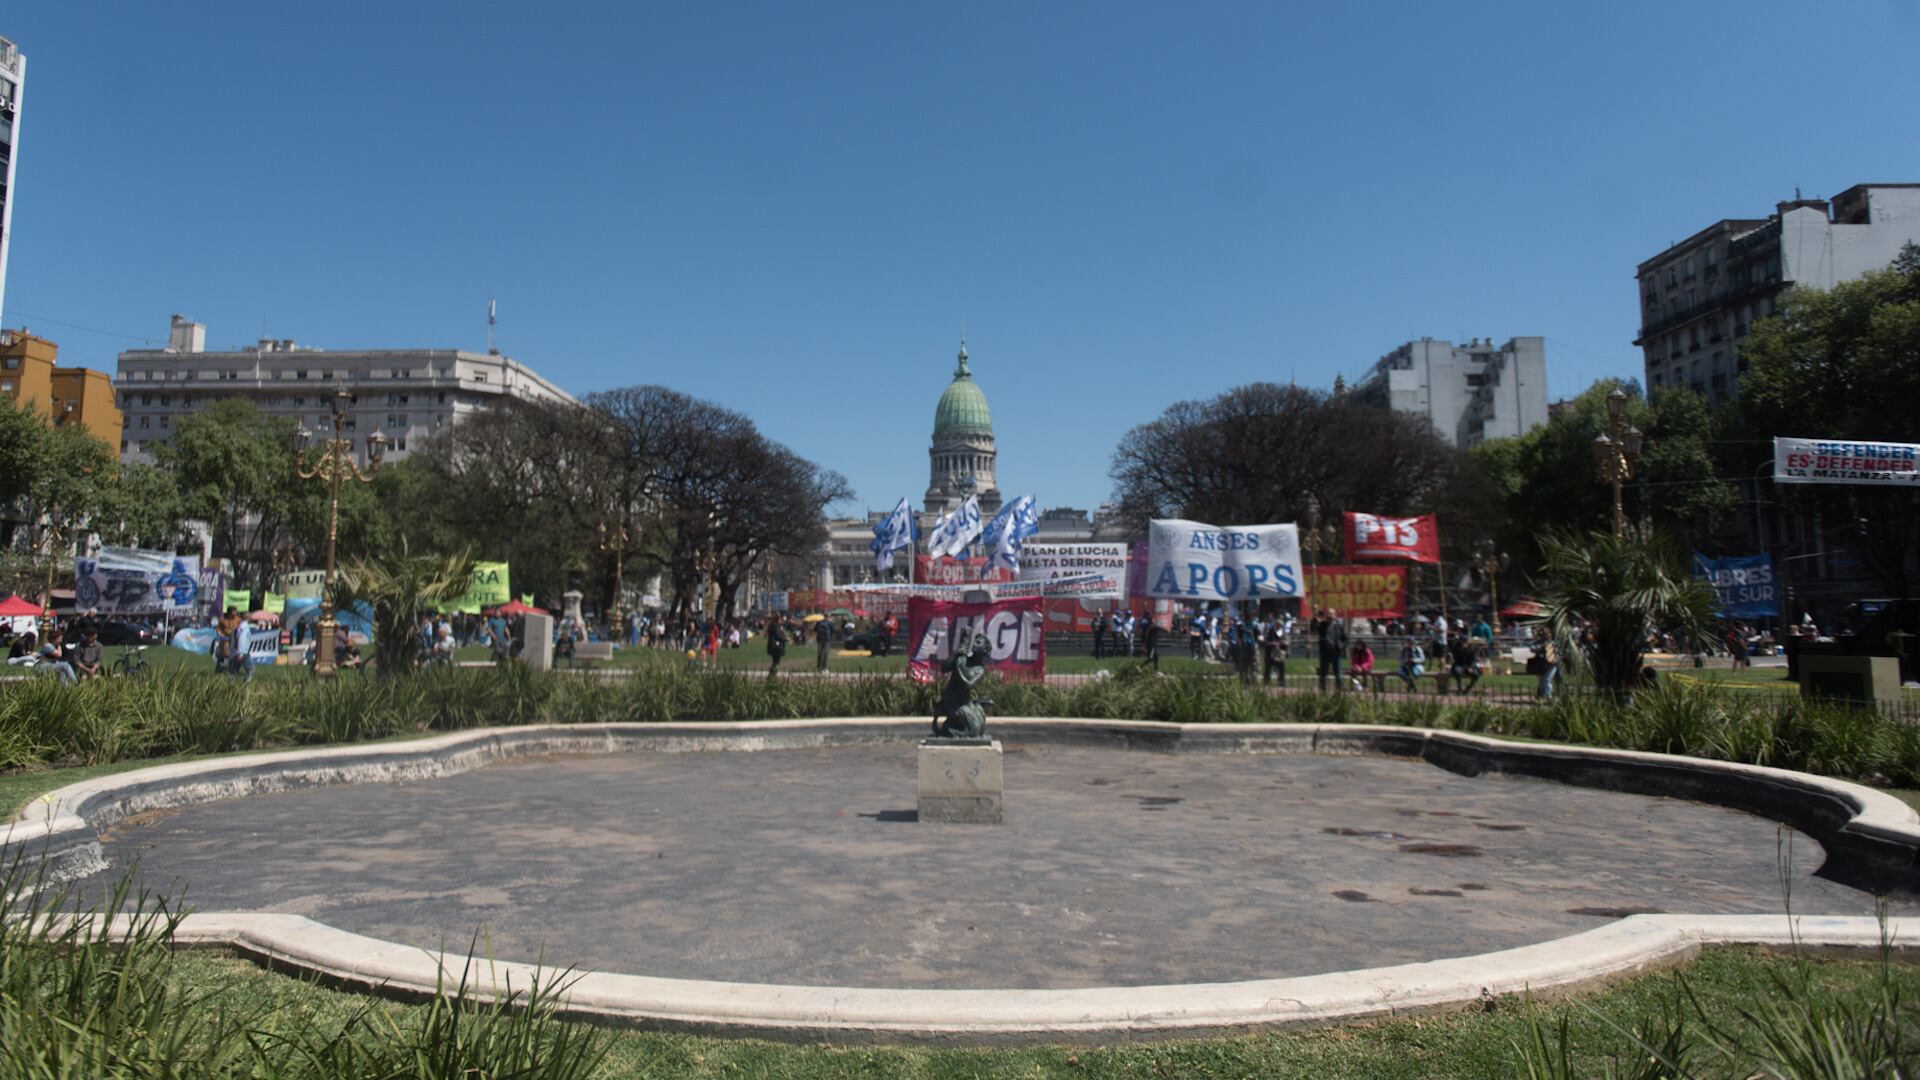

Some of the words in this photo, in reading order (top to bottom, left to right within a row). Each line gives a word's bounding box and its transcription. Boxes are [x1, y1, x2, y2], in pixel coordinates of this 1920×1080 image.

[1815, 443, 1915, 459] DEFENDER
[1816, 456, 1914, 471] DEFENDER
[1814, 470, 1891, 480] MATANZA
[1354, 513, 1418, 546] PTS
[1190, 531, 1259, 550] ANSES
[1024, 547, 1056, 555] PLAN
[1059, 547, 1075, 555] DE
[1077, 547, 1119, 556] LUCHA
[1060, 558, 1124, 569] DERROTAR
[1051, 570, 1059, 578] A
[1153, 561, 1297, 597] APOPS
[1739, 585, 1774, 603] SUR
